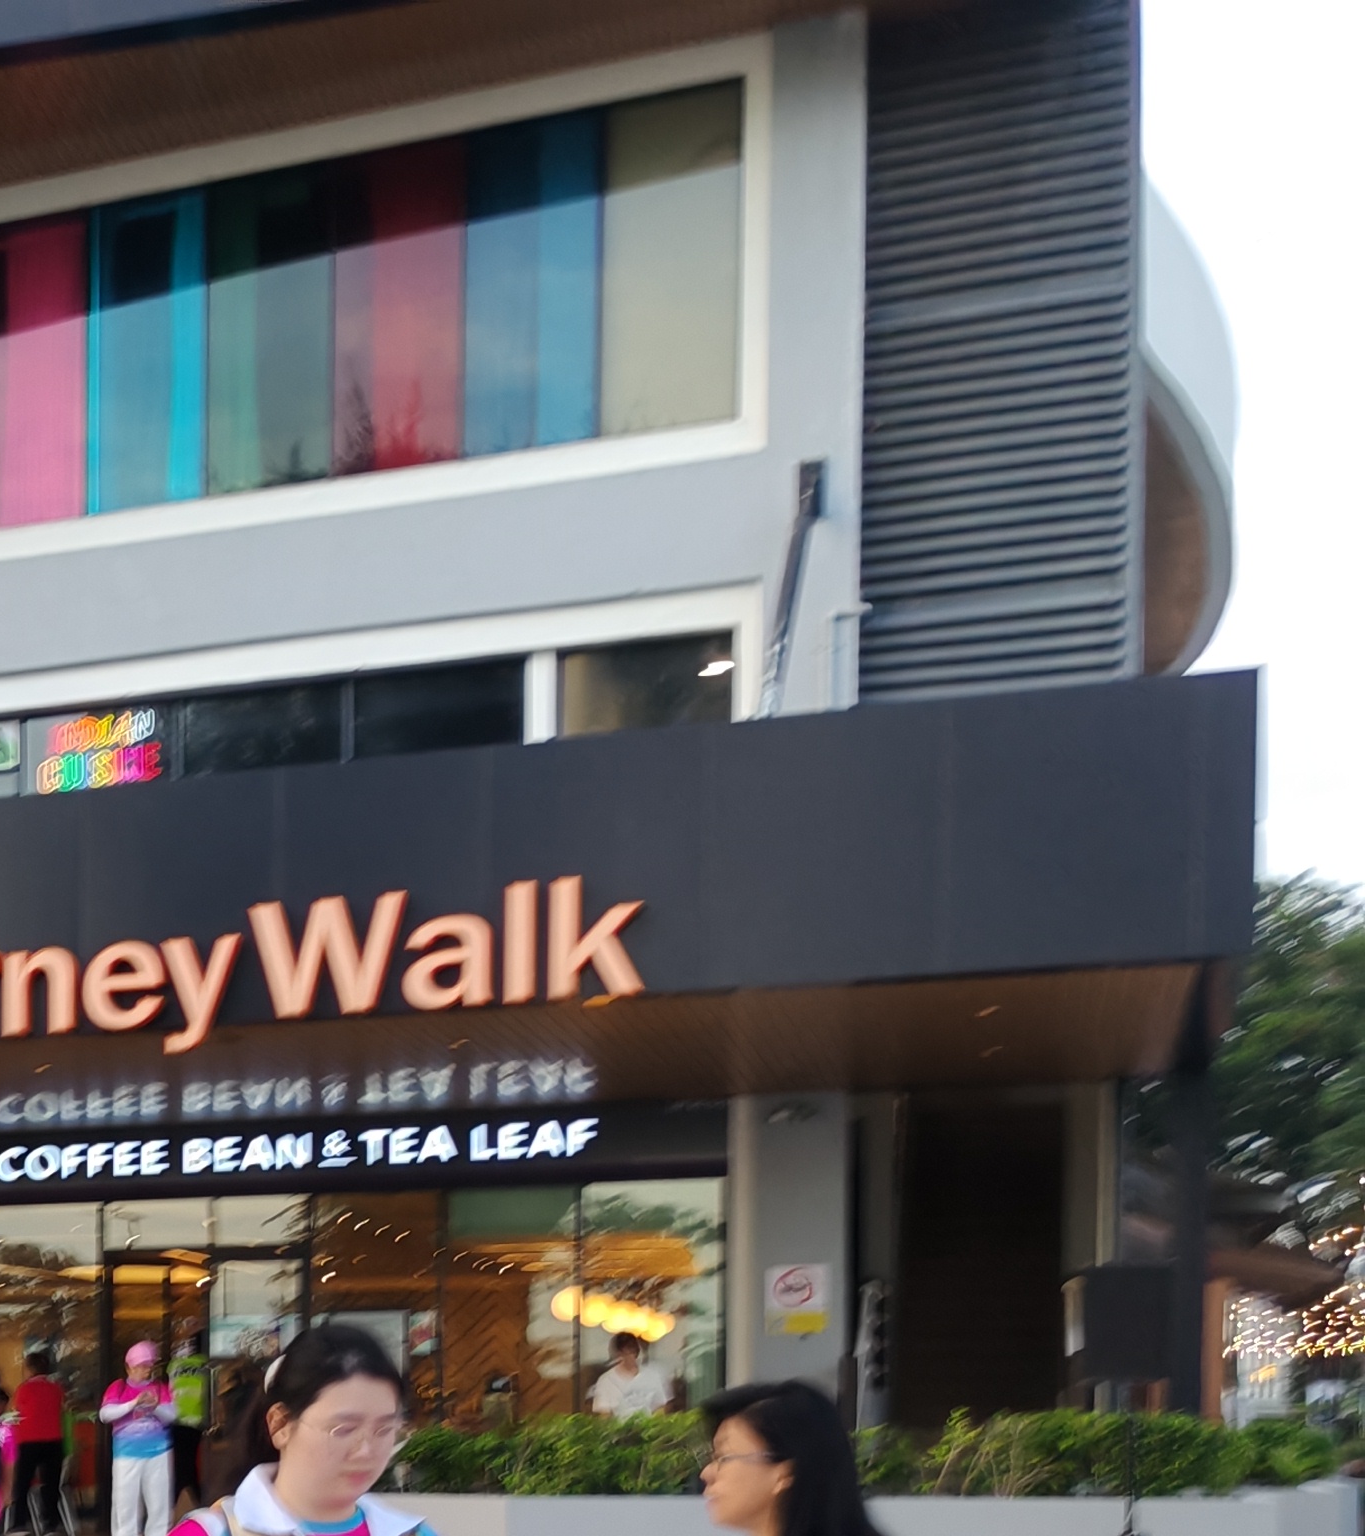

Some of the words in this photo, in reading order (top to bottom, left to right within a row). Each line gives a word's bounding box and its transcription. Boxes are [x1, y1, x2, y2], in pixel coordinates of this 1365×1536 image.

[247, 874, 646, 1020] Walk
[182, 1132, 313, 1174] BEAN
[317, 1129, 358, 1168] &
[358, 1125, 459, 1165] TEA
[470, 1118, 599, 1161] LEAF
